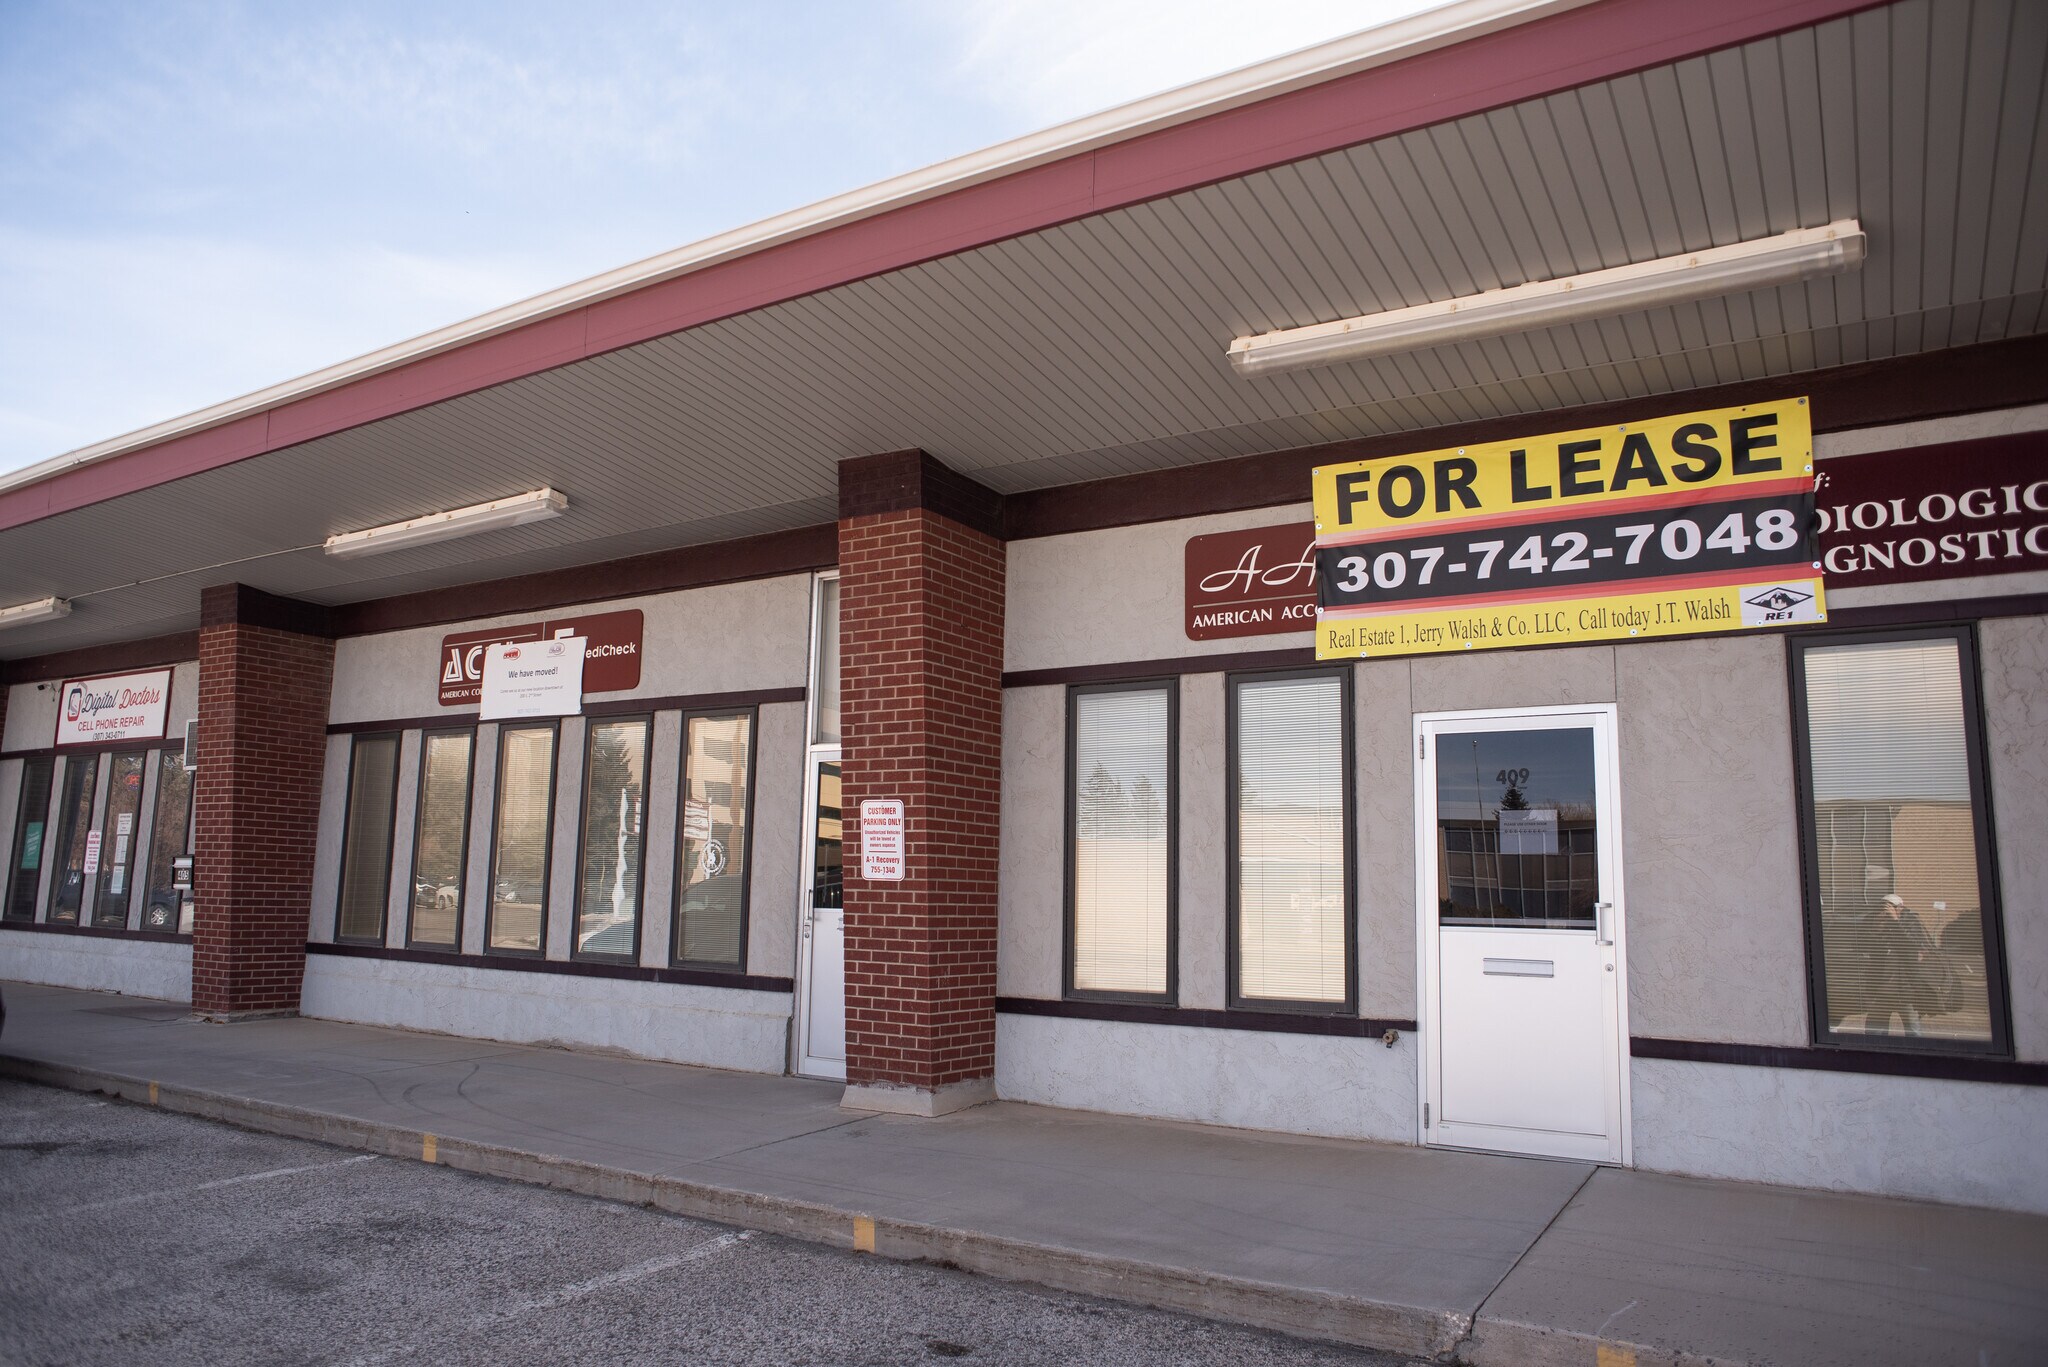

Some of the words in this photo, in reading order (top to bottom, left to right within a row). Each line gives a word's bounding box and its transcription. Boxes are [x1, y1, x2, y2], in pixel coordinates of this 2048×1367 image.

[1335, 457, 1483, 525] FOR
[1509, 413, 1783, 504] LEASE
[1336, 509, 1799, 594] 307-742-7048
[1822, 524, 2048, 574] GNOSTIC
[1193, 608, 1273, 628] AMERICAN
[1329, 628, 1355, 649] Real
[1359, 628, 1395, 647] Estate
[1400, 625, 1410, 647] 1,
[1413, 623, 1445, 646] Jerry
[1448, 618, 1487, 639] Walsh
[1491, 616, 1502, 637] &
[1507, 615, 1530, 636] Co.
[1534, 611, 1571, 636] LLC,
[1579, 608, 1607, 631] Call
[1611, 606, 1651, 631] today
[1655, 602, 1681, 625] J.T.
[1684, 597, 1731, 622] Walsh
[508, 670, 518, 678] We
[519, 670, 533, 678] have
[535, 666, 558, 676] moved!
[81, 689, 119, 716] Digital
[119, 686, 160, 709] Doctors
[441, 689, 470, 699] AMERICAN
[77, 721, 94, 732] CELL
[95, 718, 119, 730] PHONE
[119, 715, 145, 728] REPAIR
[1496, 768, 1530, 785] 409
[868, 807, 896, 815] CUSTOMER
[863, 818, 886, 826] PARKING
[876, 856, 900, 864] Recovery
